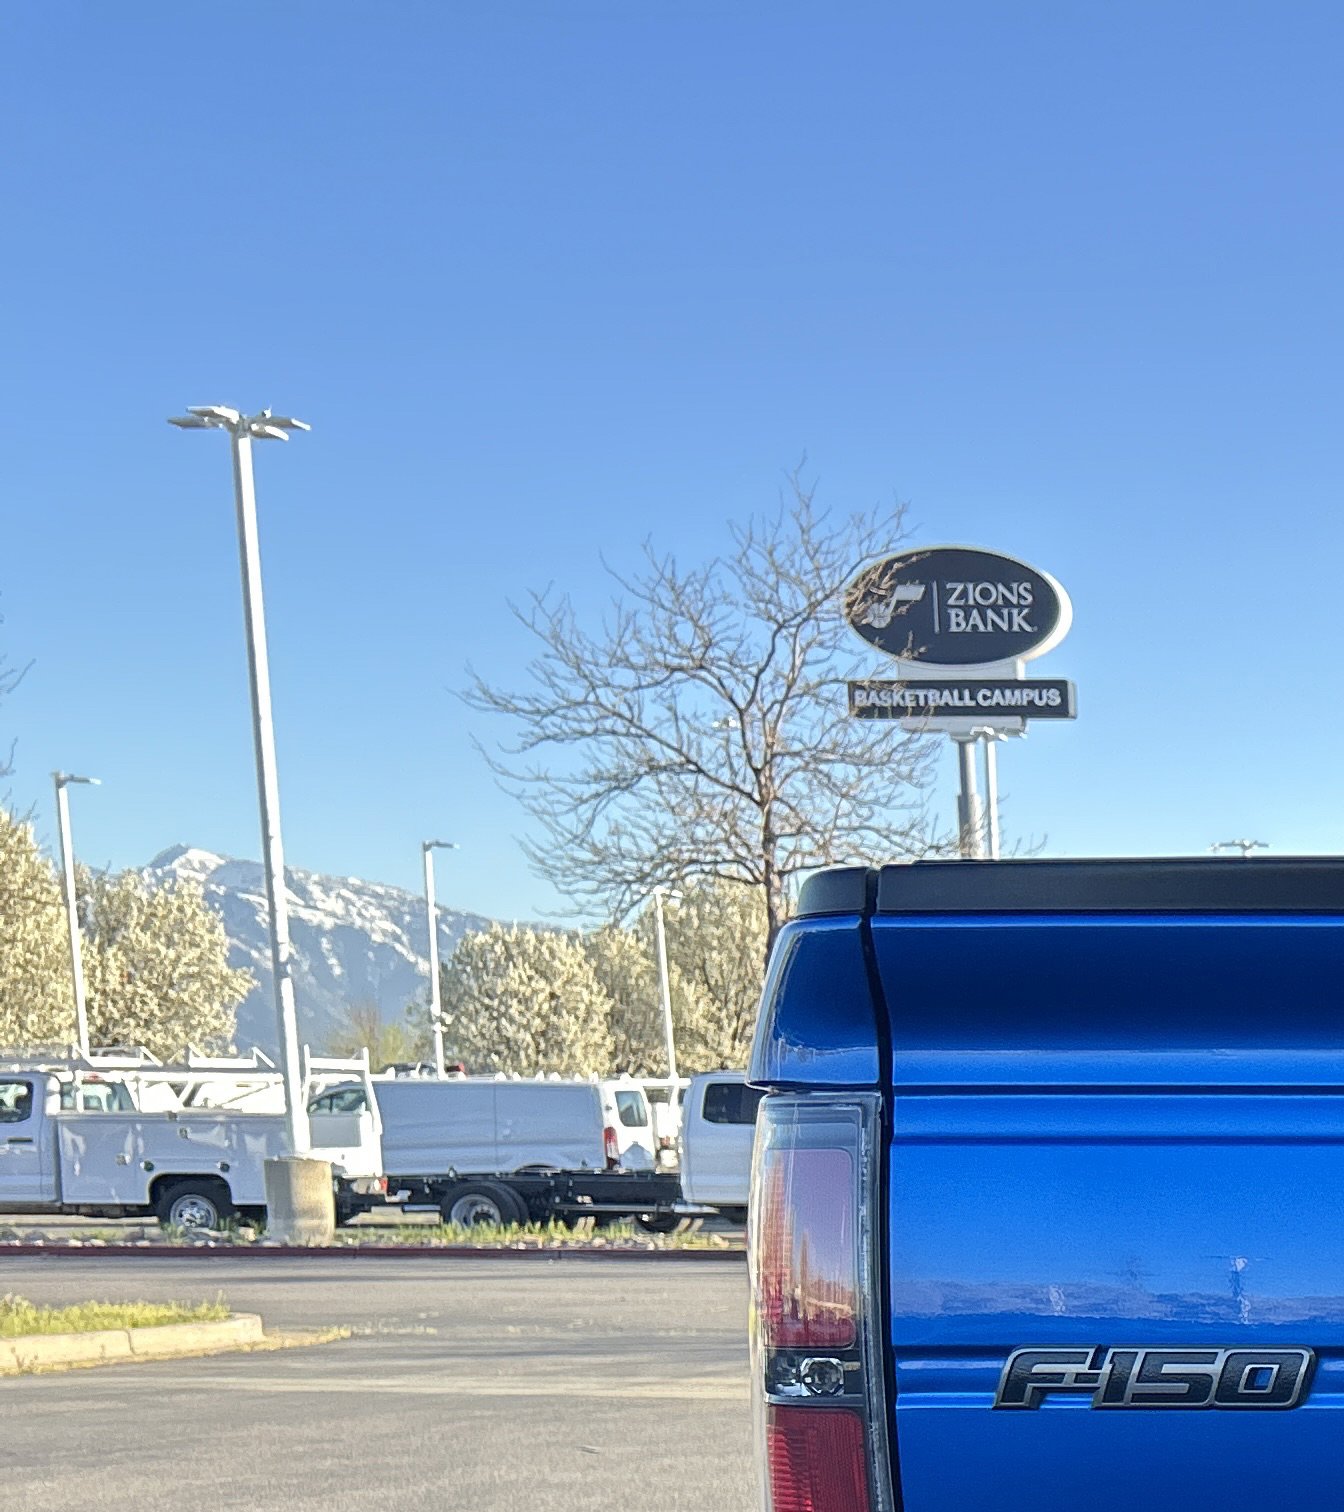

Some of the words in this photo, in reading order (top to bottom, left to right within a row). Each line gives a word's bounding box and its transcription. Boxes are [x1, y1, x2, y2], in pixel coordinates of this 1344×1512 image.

[945, 582, 1034, 605] ZIONS
[947, 607, 1034, 632] BANK
[853, 689, 977, 707] BASKETBALL
[977, 688, 1061, 707] CAMPUS
[991, 1344, 1317, 1410] F-150
